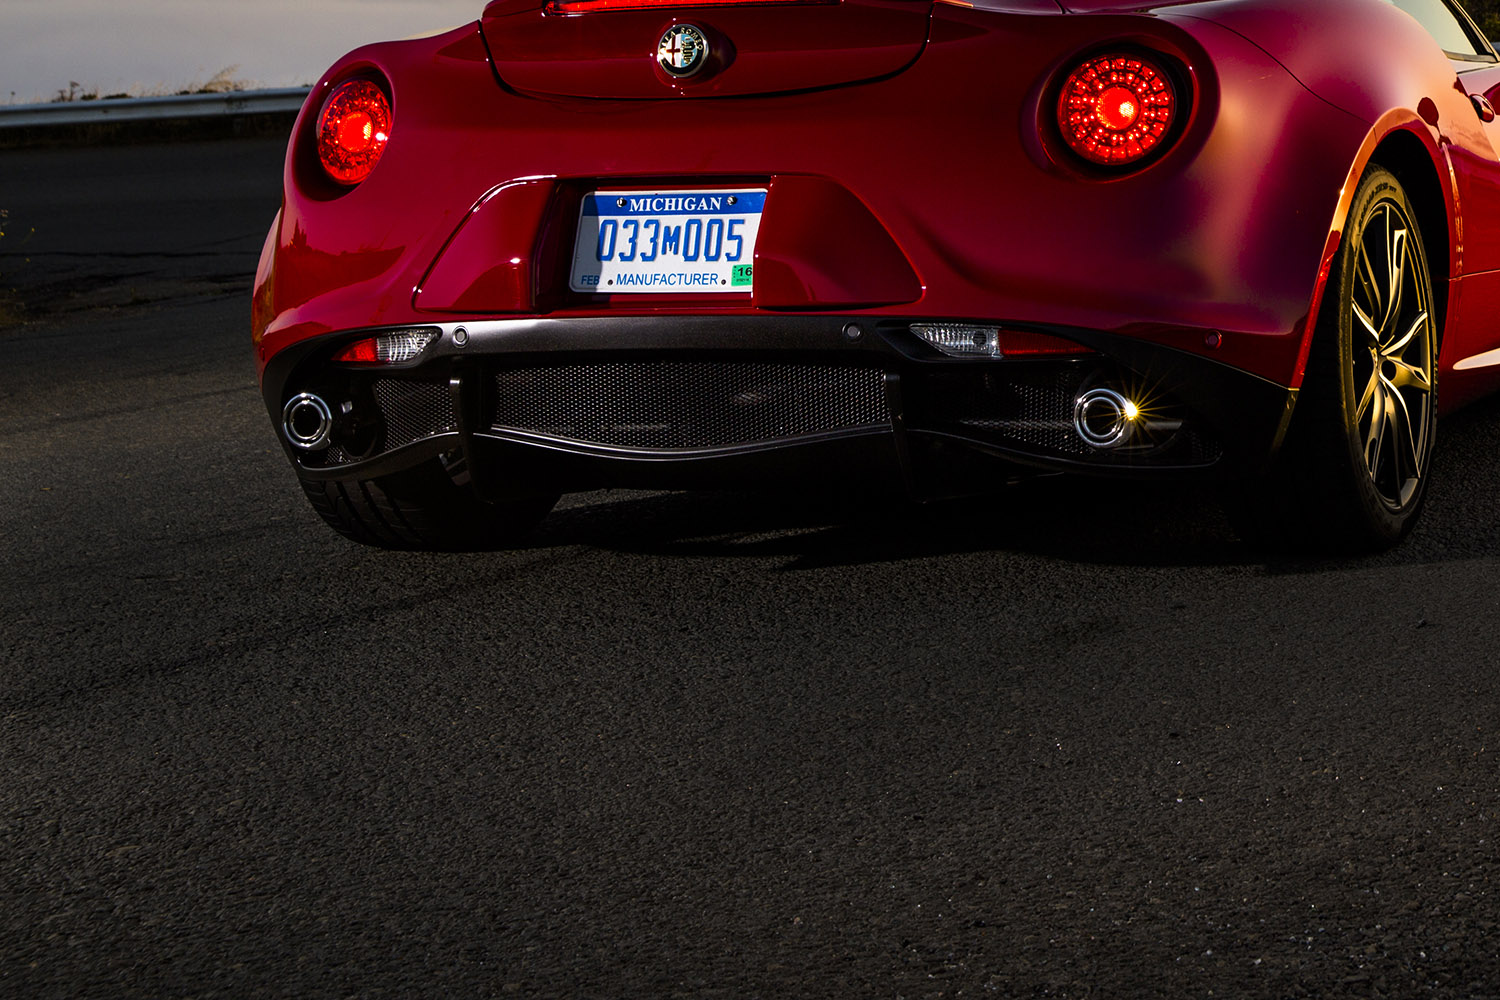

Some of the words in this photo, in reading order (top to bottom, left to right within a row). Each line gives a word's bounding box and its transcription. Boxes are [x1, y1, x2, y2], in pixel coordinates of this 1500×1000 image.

[629, 197, 722, 212] MICHIGAN
[597, 218, 745, 262] 033M005
[737, 267, 752, 277] 16
[581, 275, 599, 285] FEB
[616, 273, 718, 286] MANUFACTURER
